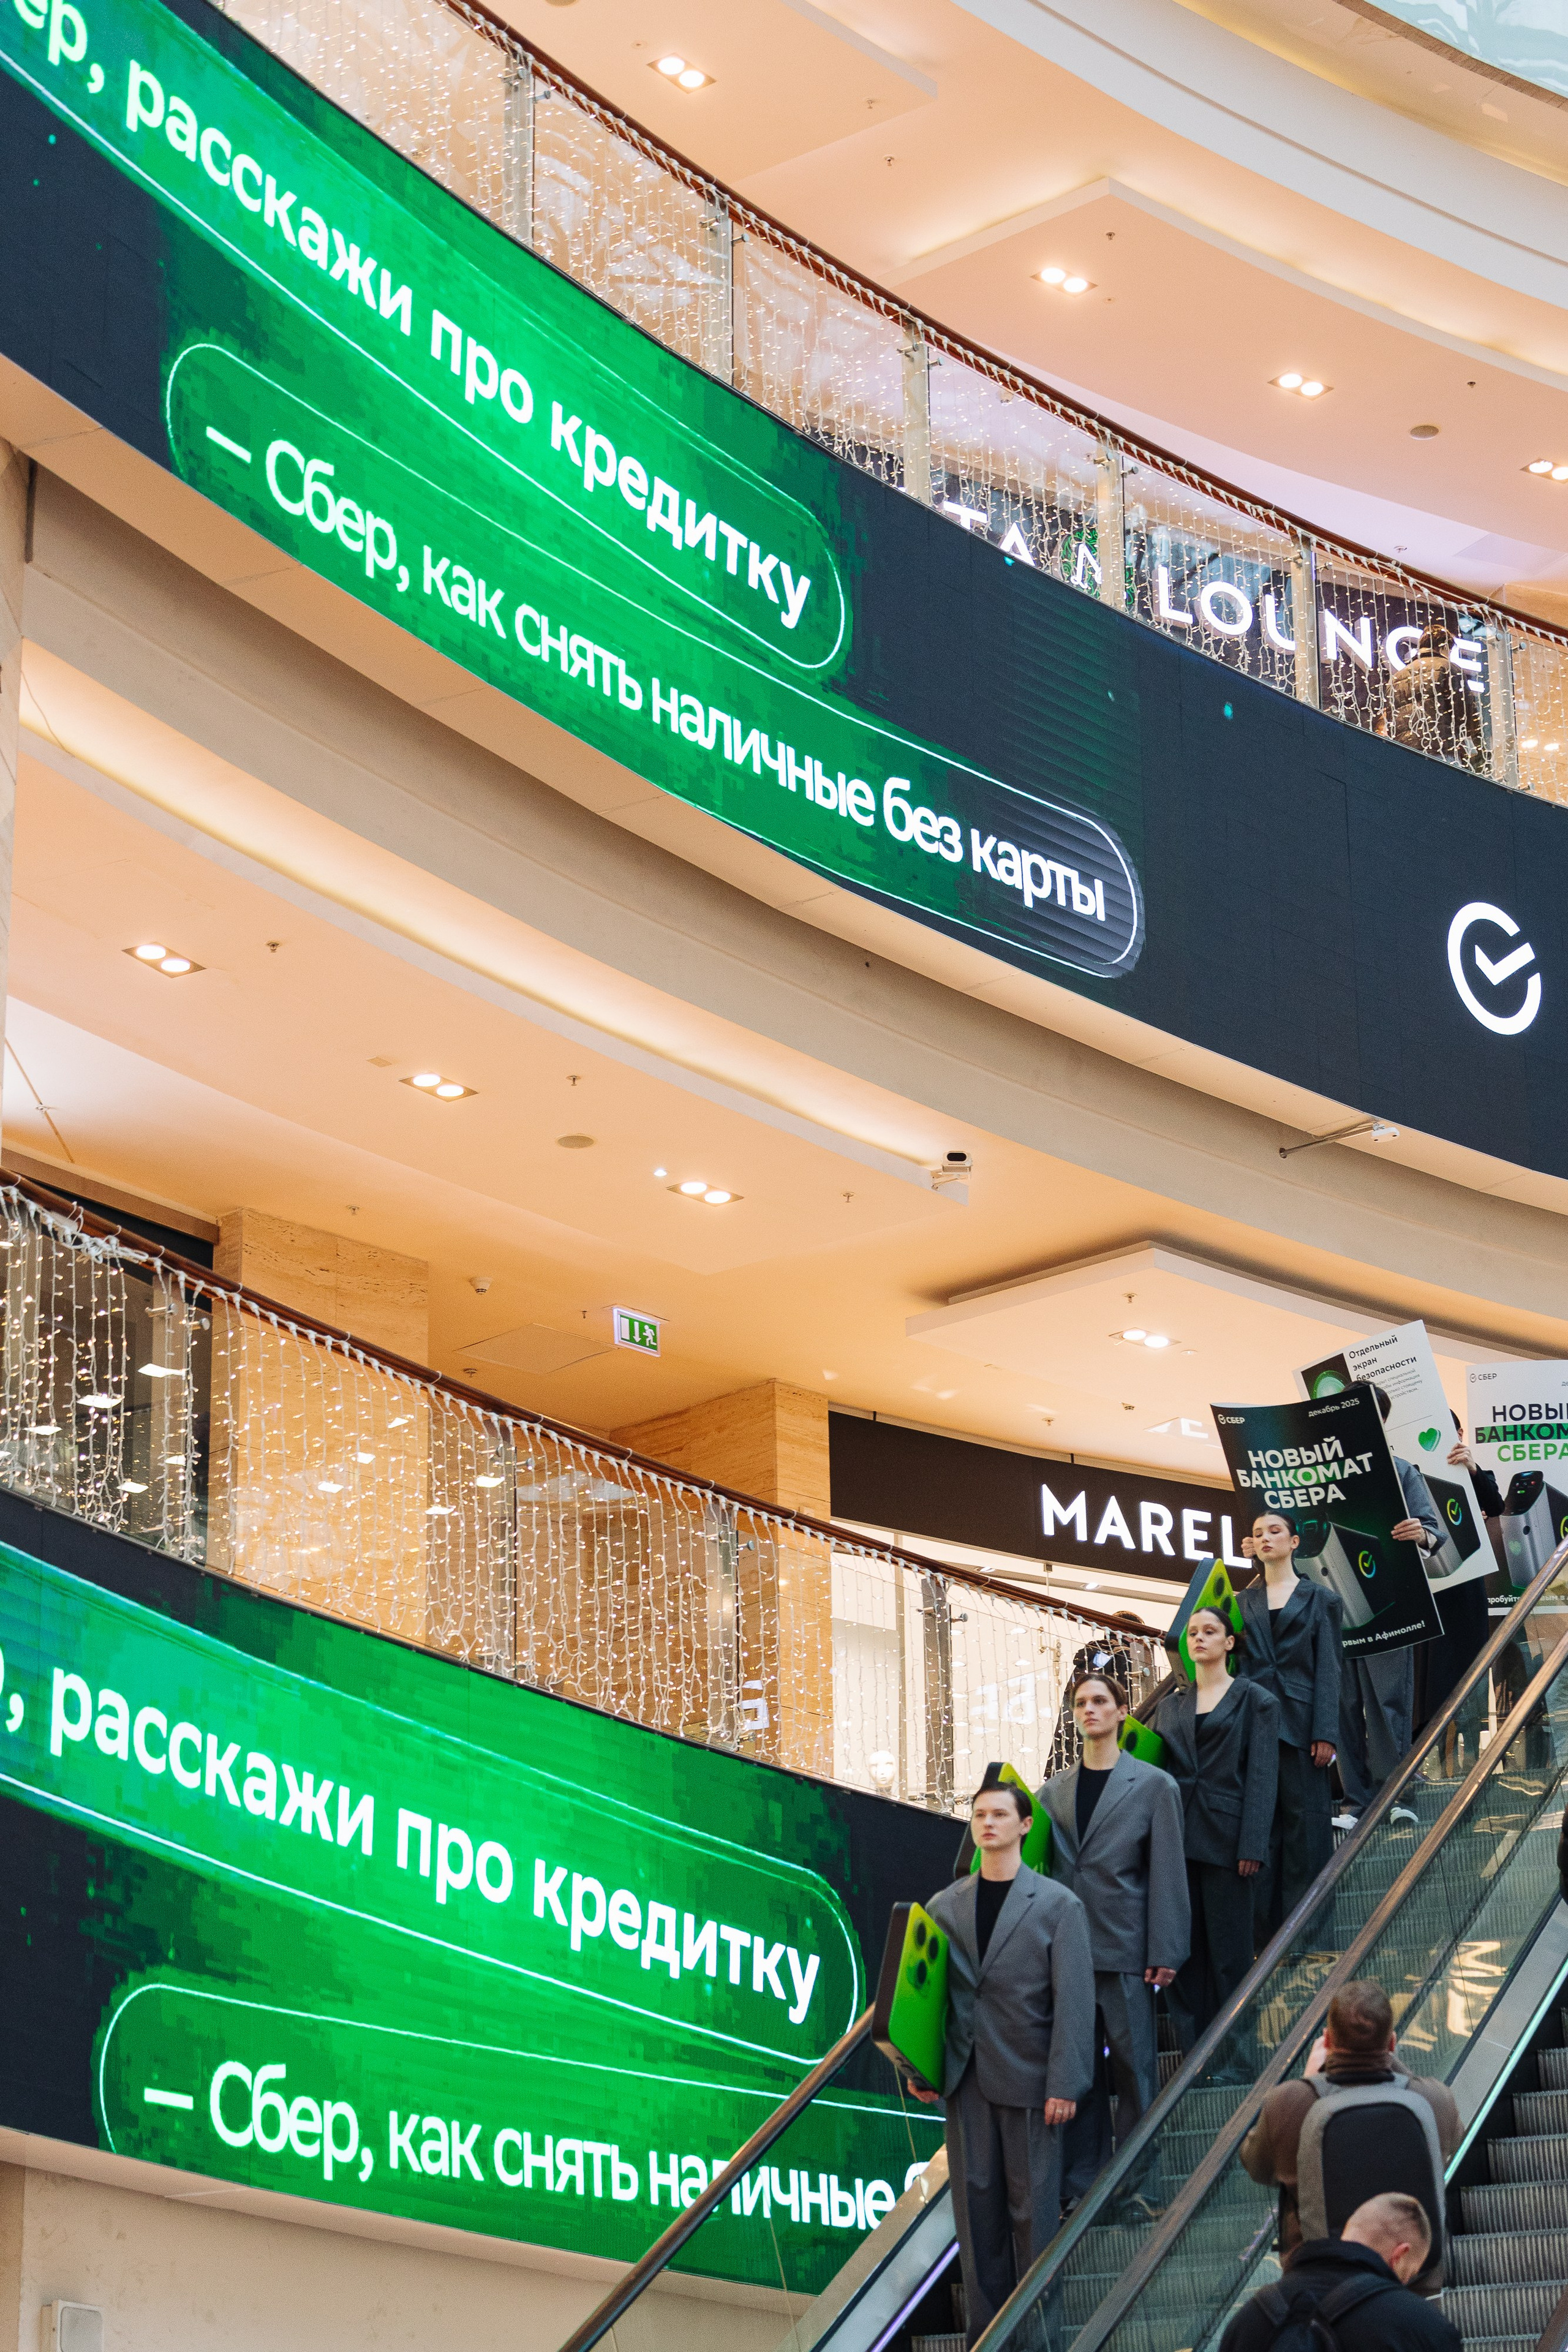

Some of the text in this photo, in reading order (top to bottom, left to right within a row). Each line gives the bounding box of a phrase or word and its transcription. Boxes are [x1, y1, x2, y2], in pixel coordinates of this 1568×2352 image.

[126, 59, 413, 336] расскажи
[431, 309, 533, 424] про
[550, 401, 811, 630] кредитку
[265, 439, 410, 592] Сбер,
[423, 545, 507, 639] как
[514, 603, 643, 710] снять
[651, 677, 876, 827] наличные
[883, 776, 963, 863] без
[970, 827, 1106, 922] карты
[1348, 1335, 1398, 1359] Отдельный
[1352, 1356, 1378, 1371] экран
[1356, 1356, 1417, 1381] безопасности
[1308, 1398, 1360, 1417] декабрь 2025
[1492, 1403, 1568, 1423] НОВЫ
[1247, 1436, 1344, 1469] НОВЫЙ
[1235, 1452, 1373, 1489] БАНКОМАТ
[1264, 1483, 1347, 1509] СБЕРА
[1041, 1483, 1253, 1569] MAREL
[1375, 1620, 1426, 1641] Афимолле!
[50, 1667, 374, 1856] расскажи
[396, 1807, 513, 1905] про
[533, 1858, 820, 2025] кредитку
[209, 2060, 374, 2182] Сбер,
[389, 2111, 484, 2181] как
[494, 2128, 639, 2201] снять
